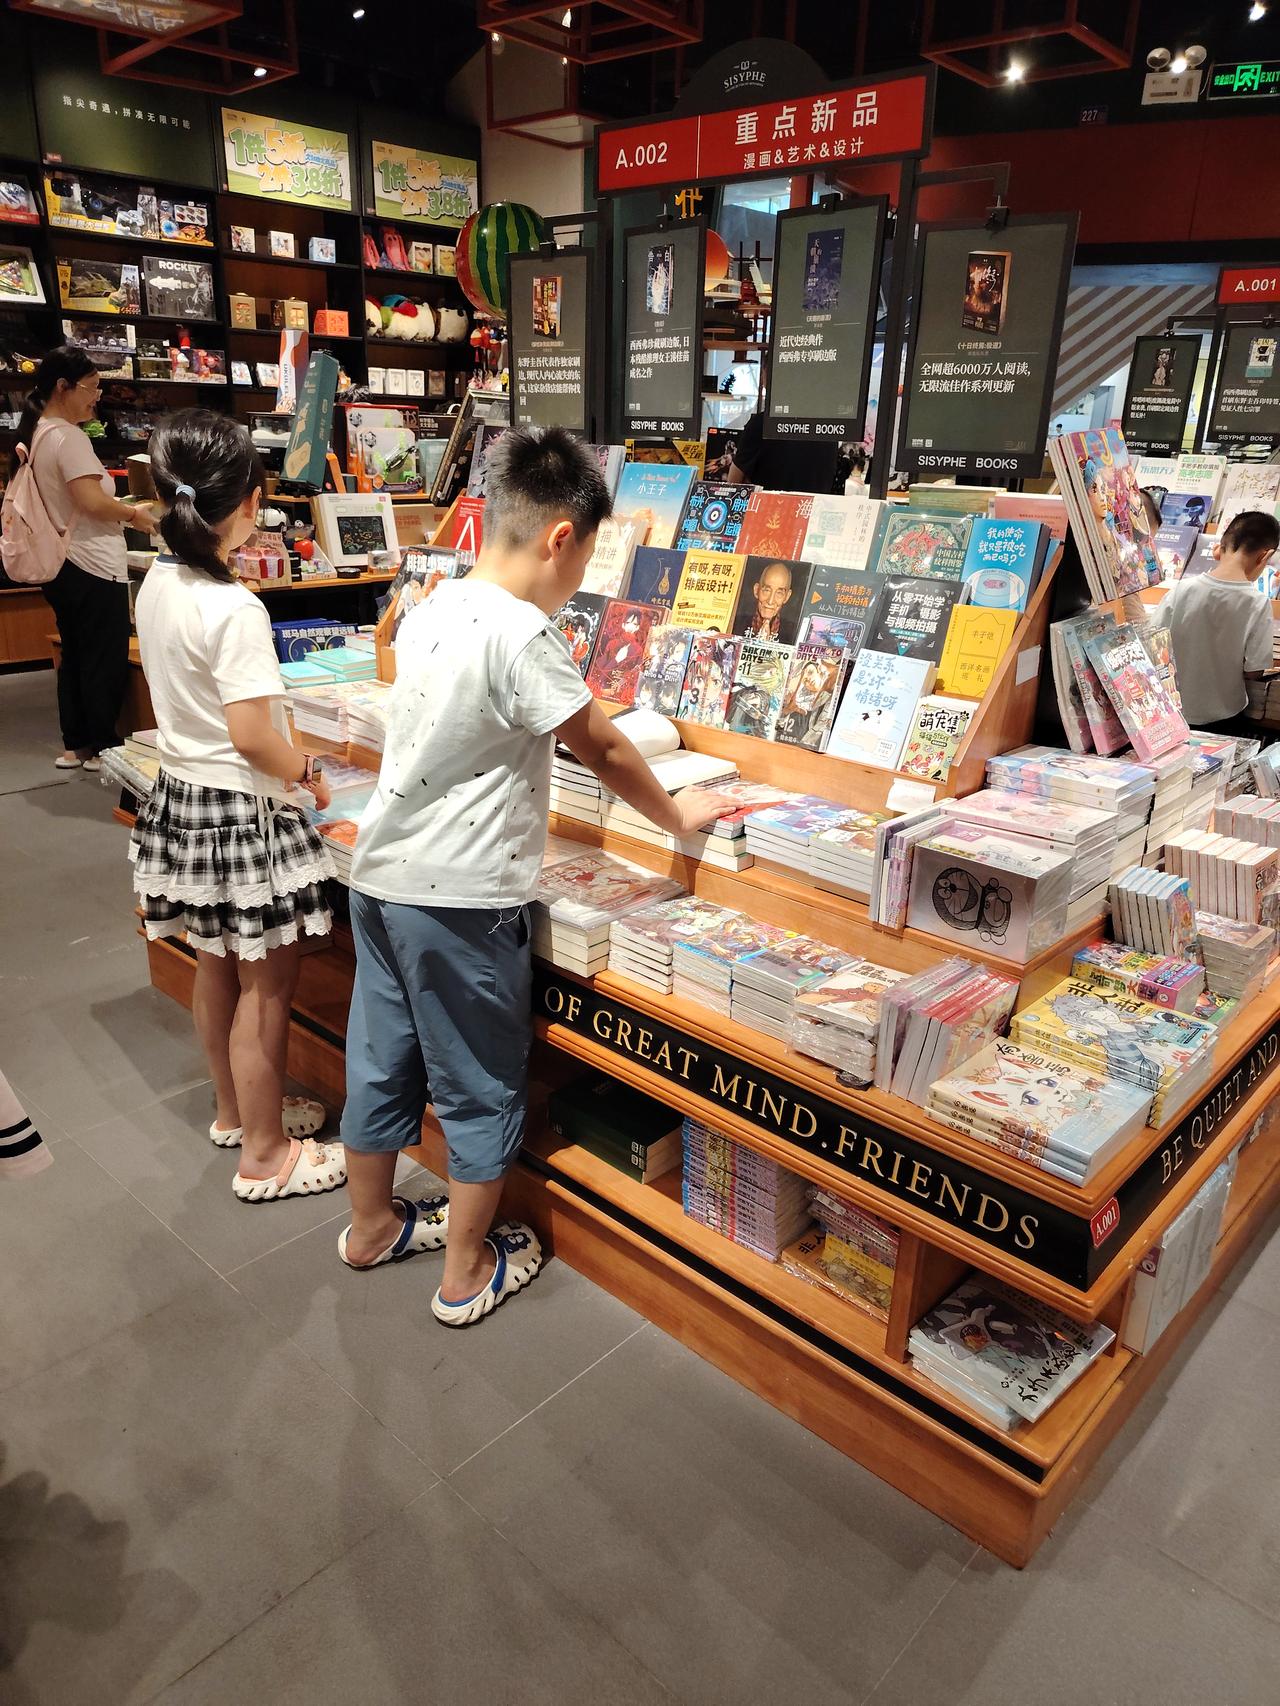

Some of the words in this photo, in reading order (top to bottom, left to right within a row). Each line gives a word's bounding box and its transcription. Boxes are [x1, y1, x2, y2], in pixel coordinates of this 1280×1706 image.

[723, 71, 767, 89] SISYPHE
[1260, 71, 1280, 82] EXIT
[734, 91, 878, 145] 重点新品
[1081, 109, 1098, 121] 227
[229, 127, 306, 166] 1件5折
[743, 137, 864, 170] 漫画&艺术&设计
[615, 142, 668, 169] A.002
[158, 260, 202, 273] ROCKET
[1235, 278, 1277, 292] A.001
[779, 333, 824, 348] 近代史经典作
[918, 379, 1016, 393] 无限流佳作系列更新
[630, 421, 657, 431] SISYPHE
[661, 421, 685, 432] BOOKS
[777, 423, 810, 434] SISYPHE
[815, 424, 845, 435] BOOKS
[1151, 442, 1169, 450] BOOKS
[918, 455, 967, 468] SISYPHE
[975, 457, 1018, 470] BOOKS
[637, 482, 667, 496] 小王子
[987, 527, 1025, 540] 我的使命
[684, 578, 734, 594] 排版设计!
[892, 591, 946, 607] 从零开始学
[889, 604, 909, 616] 手机
[885, 616, 938, 634] 与视频拍摄
[741, 654, 764, 664] DAYS
[920, 709, 959, 734] 萌宠集
[1067, 982, 1145, 1013] 非人哉
[544, 986, 582, 1022] OF
[593, 1010, 700, 1080] GREAT
[1161, 1135, 1184, 1184] BE
[1190, 1069, 1243, 1149] QUIET
[1247, 1033, 1280, 1087] AND
[1096, 1207, 1117, 1240] A.001
